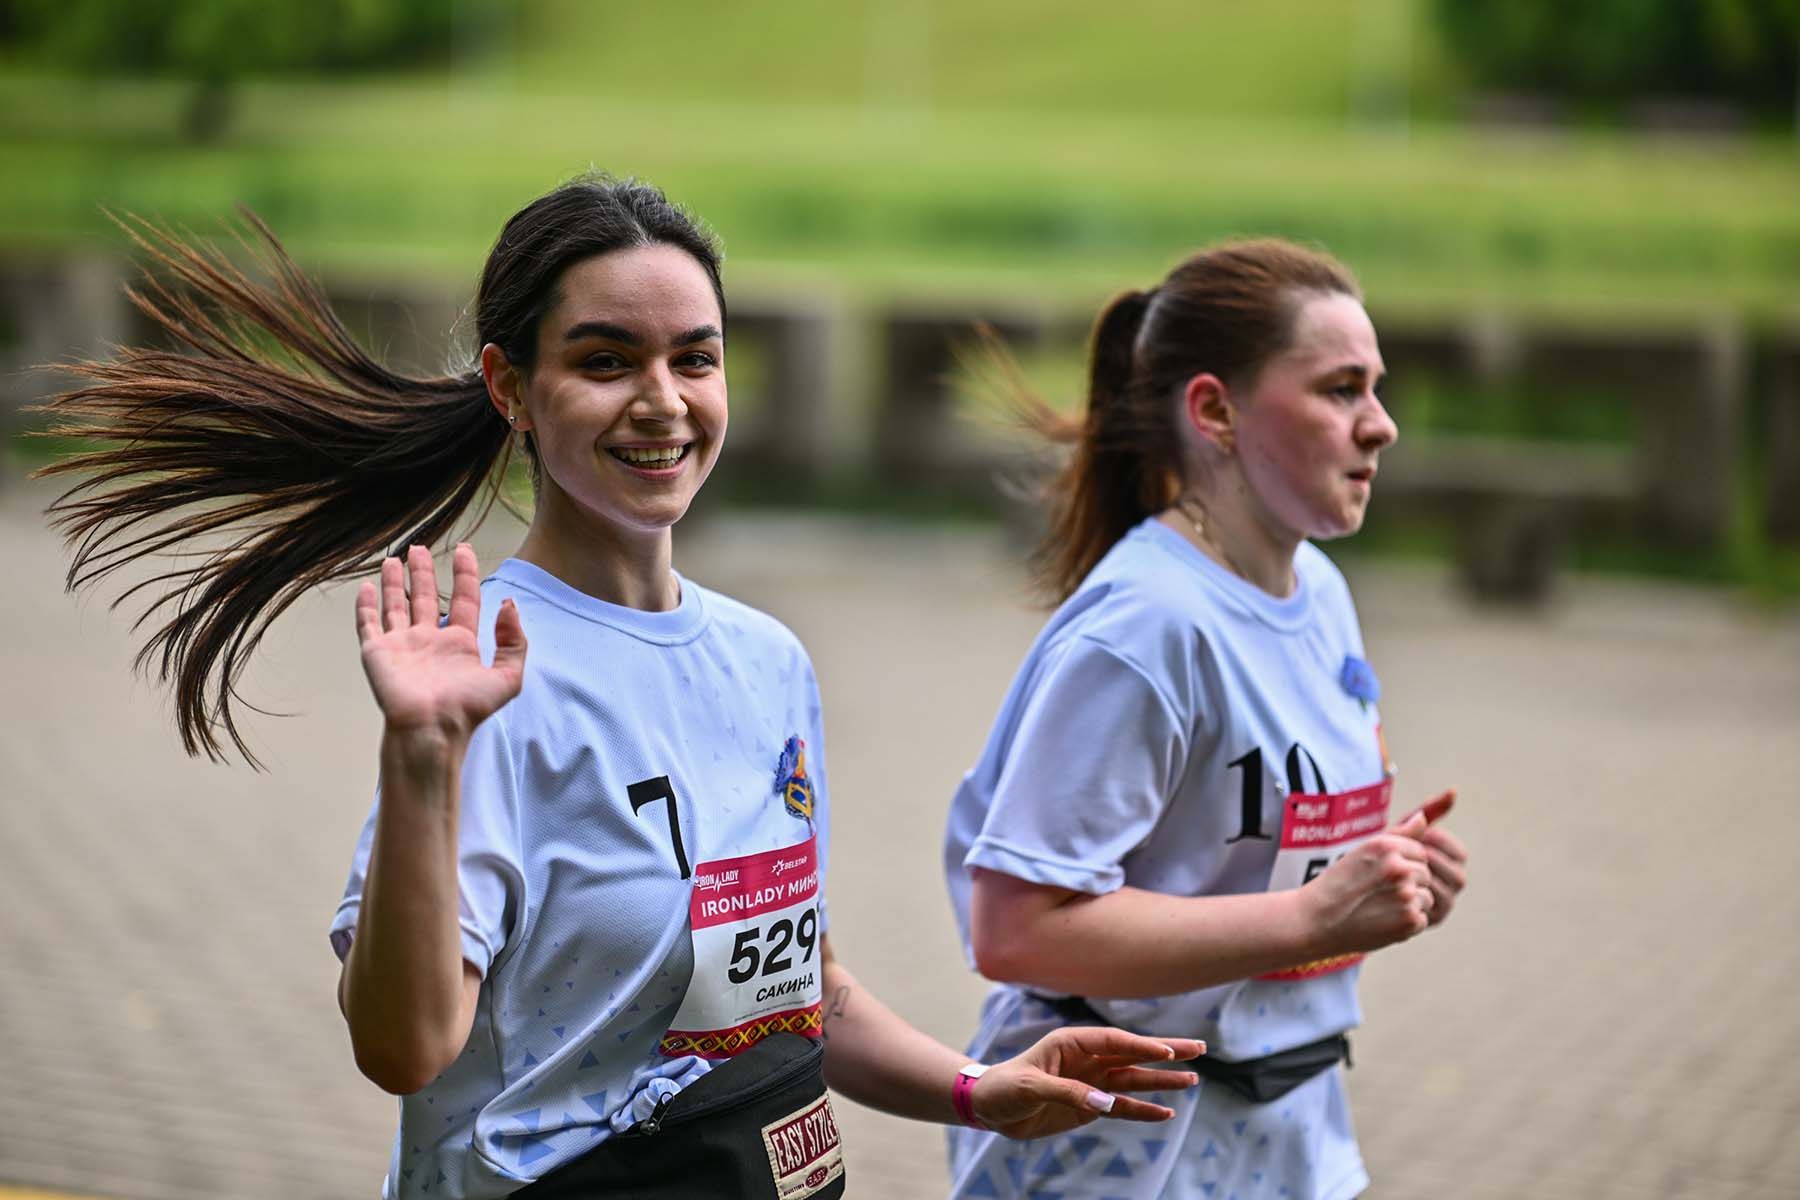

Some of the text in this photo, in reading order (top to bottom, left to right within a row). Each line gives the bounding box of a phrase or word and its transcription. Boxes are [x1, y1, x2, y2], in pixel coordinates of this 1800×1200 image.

[627, 775, 691, 880] 7
[721, 870, 739, 883] LADY
[784, 856, 807, 870] BELSTAR
[701, 885, 785, 918] IRONLADY
[728, 901, 819, 984] 529
[756, 972, 814, 1002] САКИНА
[771, 1122, 807, 1174] EASY
